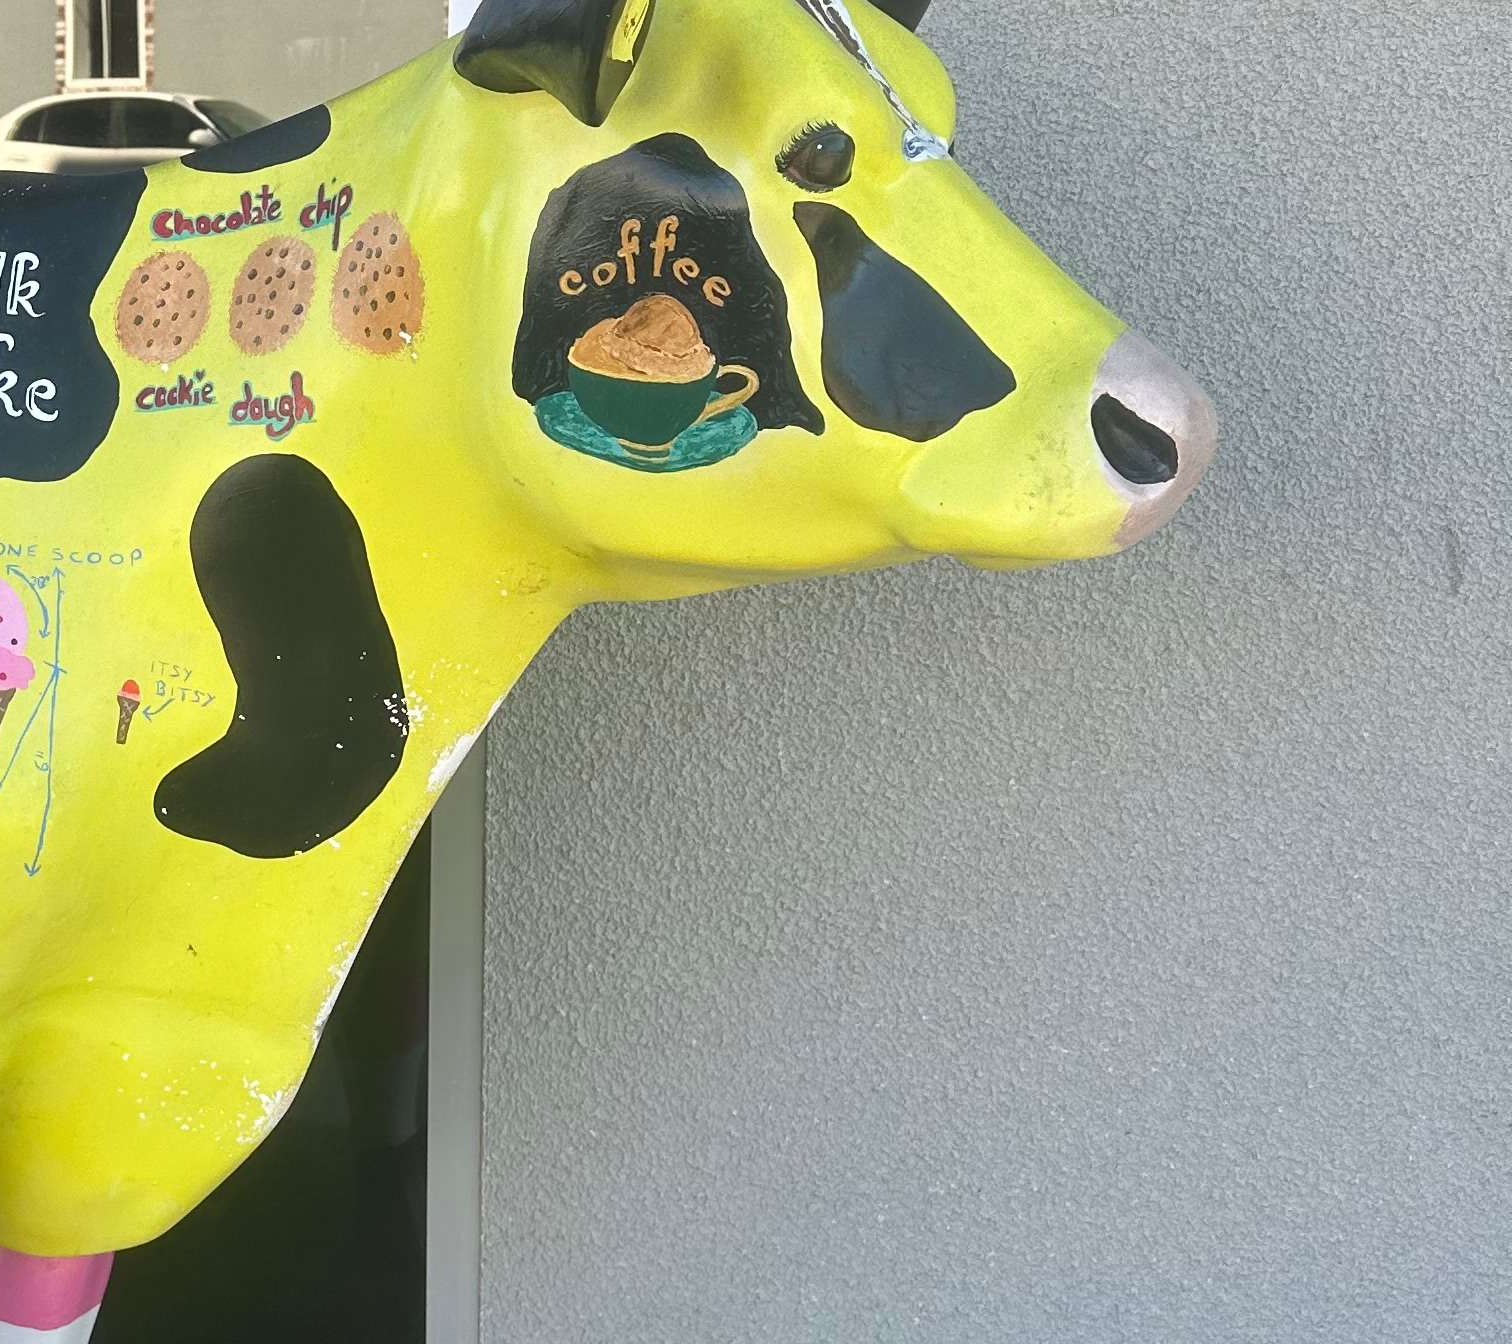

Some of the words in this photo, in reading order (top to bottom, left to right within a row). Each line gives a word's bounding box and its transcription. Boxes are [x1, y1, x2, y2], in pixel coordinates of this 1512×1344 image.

[299, 177, 354, 251] chip
[559, 214, 733, 307] coffee
[230, 370, 315, 441] dough
[52, 548, 143, 568] SCOOP
[150, 659, 193, 682] ITSY
[156, 679, 216, 707] BITSY
